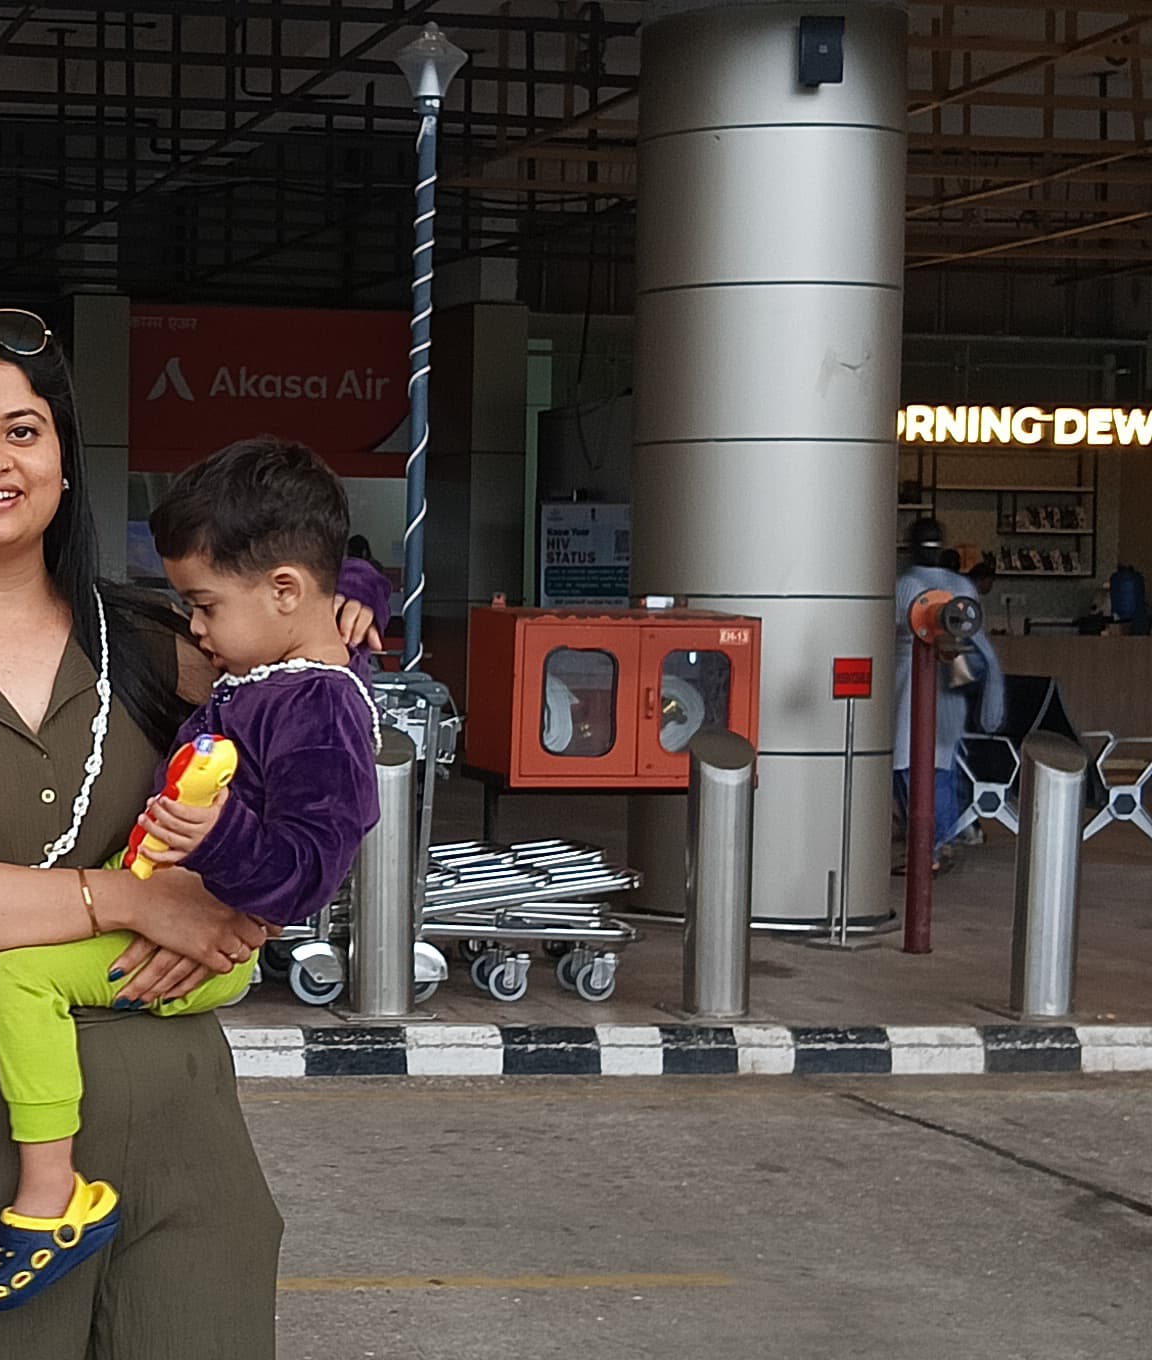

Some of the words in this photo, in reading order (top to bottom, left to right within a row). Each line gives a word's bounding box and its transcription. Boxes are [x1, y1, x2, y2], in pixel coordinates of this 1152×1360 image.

[208, 365, 328, 399] Akasa
[335, 367, 391, 401] Air
[546, 537, 570, 550] HIV
[546, 551, 595, 564] STATUS
